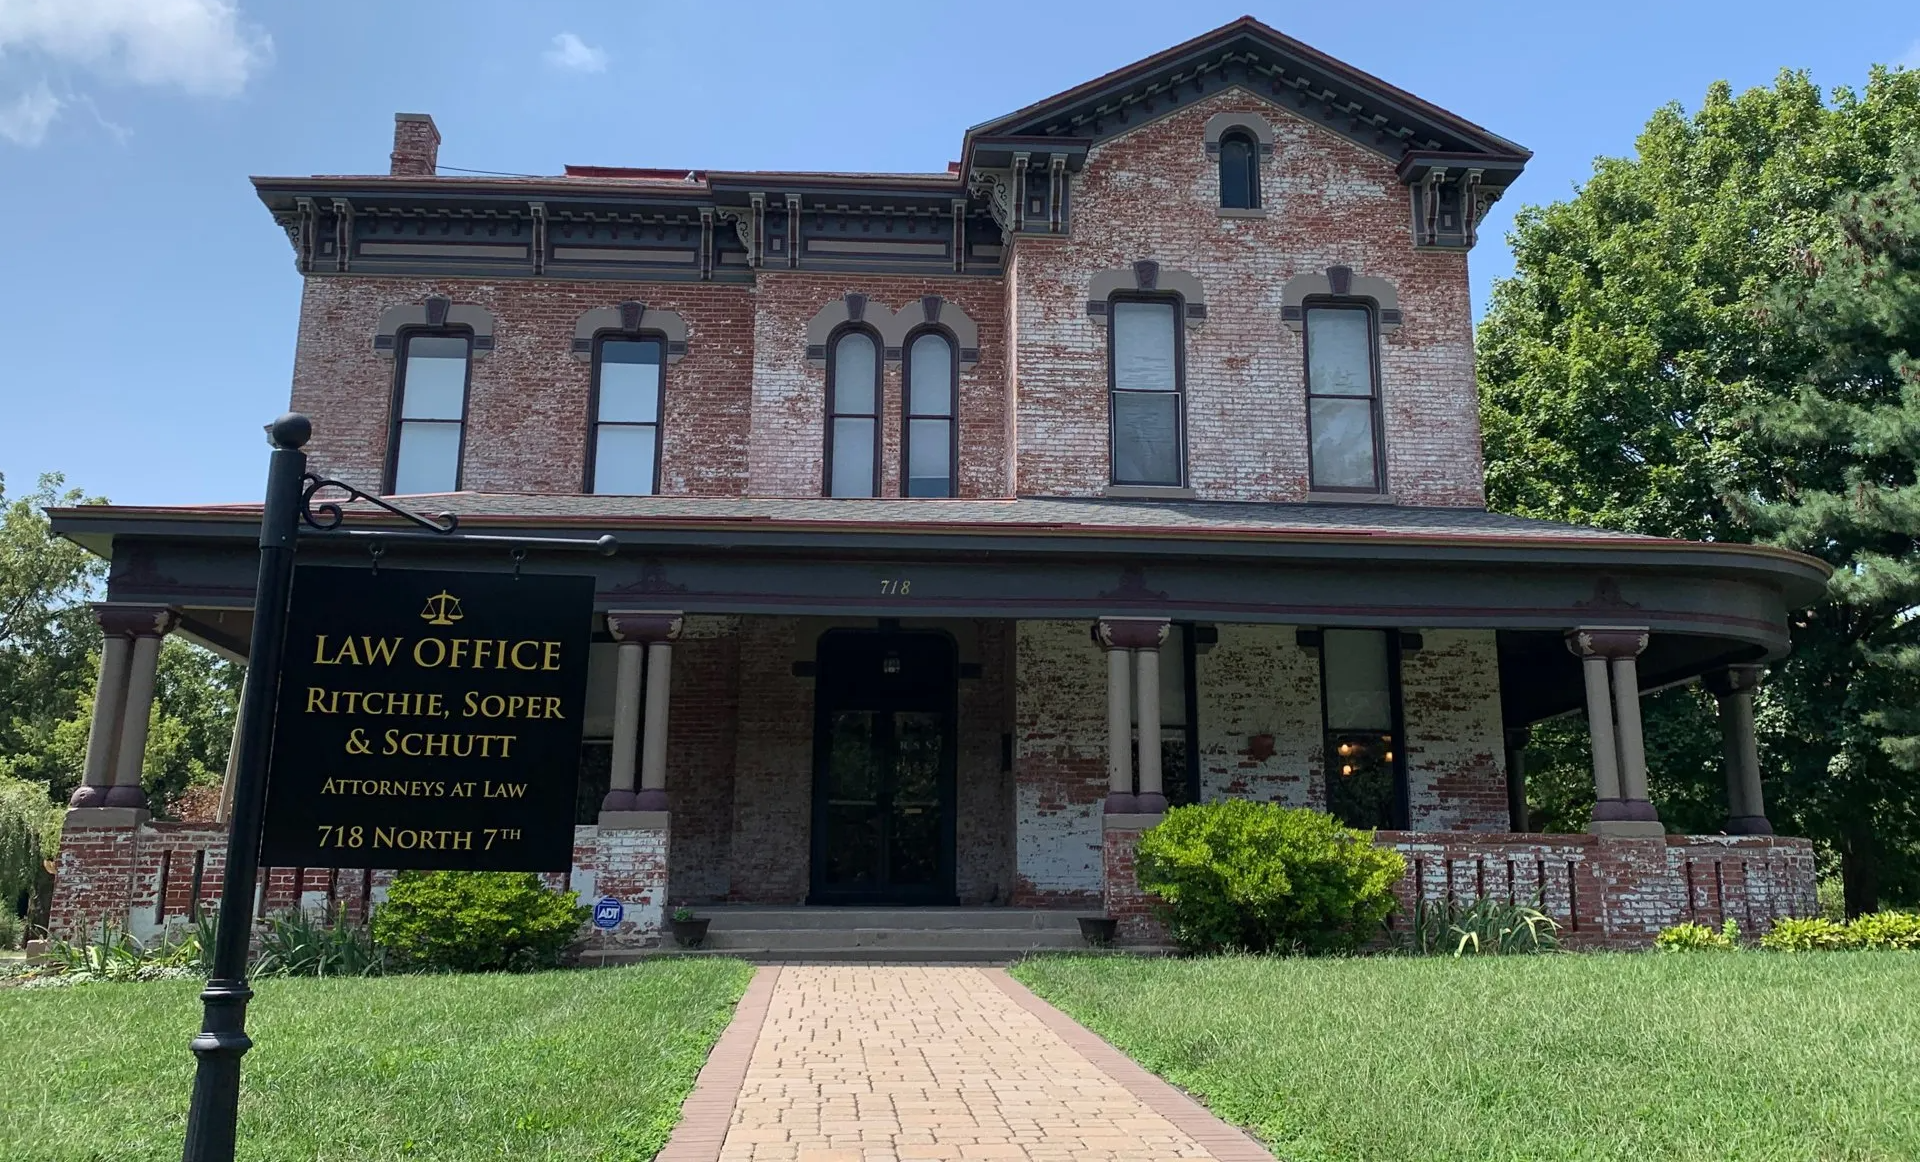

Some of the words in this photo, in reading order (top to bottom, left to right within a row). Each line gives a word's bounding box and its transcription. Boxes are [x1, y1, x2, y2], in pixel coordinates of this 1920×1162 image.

[880, 580, 911, 595] 718
[313, 634, 404, 667] LAW
[413, 637, 562, 671] OFFICE
[305, 687, 451, 719] RITCHIE,
[462, 691, 566, 719] SOPER
[345, 728, 374, 755] &
[382, 729, 517, 758] SCHUTT
[321, 777, 445, 798] ATTORNEYS
[450, 782, 477, 798] AT
[483, 780, 529, 798] LAW
[317, 825, 364, 849] 718
[372, 826, 473, 850] NORTH
[597, 907, 620, 919] ADT
